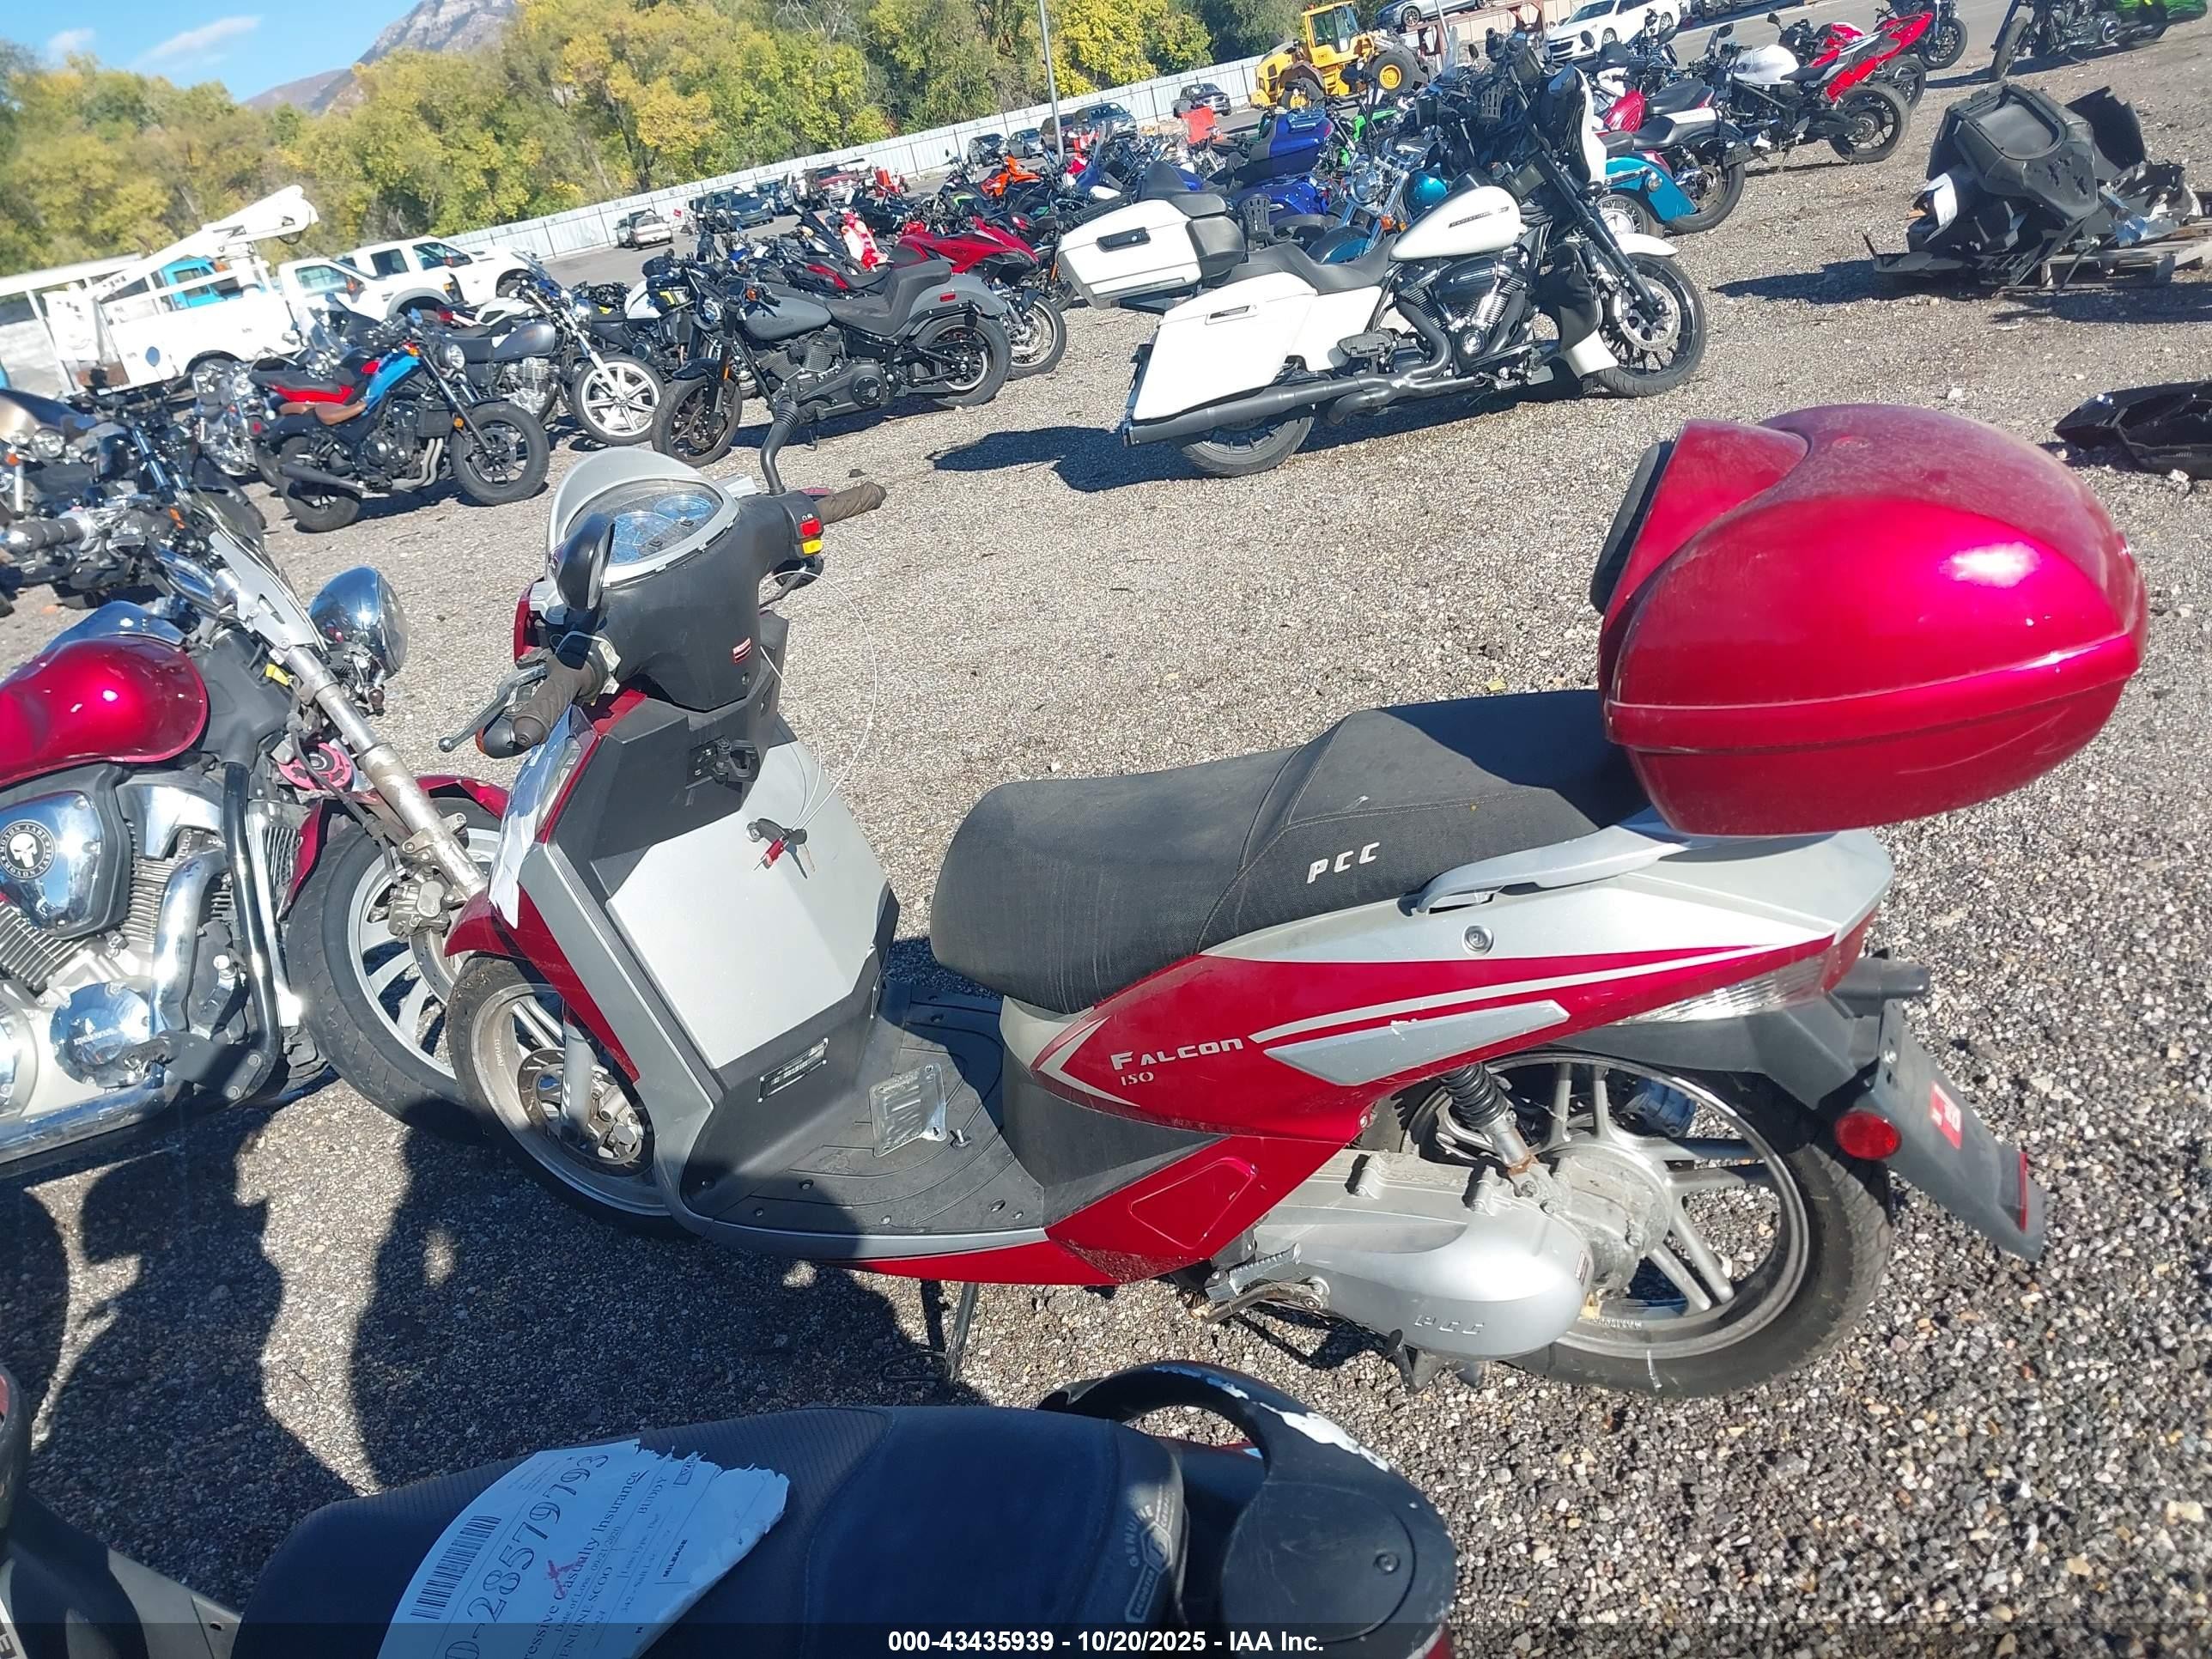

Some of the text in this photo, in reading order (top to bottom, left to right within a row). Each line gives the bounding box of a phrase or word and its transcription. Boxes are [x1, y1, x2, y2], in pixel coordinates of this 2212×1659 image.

[1307, 842, 1380, 884] PCC
[1121, 1072, 1154, 1086] 150
[1414, 1314, 1484, 1335] PCC
[637, 1477, 667, 1514] BUDDY
[554, 1537, 599, 1600] Casualty
[592, 1471, 641, 1532] Insurance
[1125, 1504, 1153, 1567] GENUINE
[662, 1539, 687, 1577] MILEAGE
